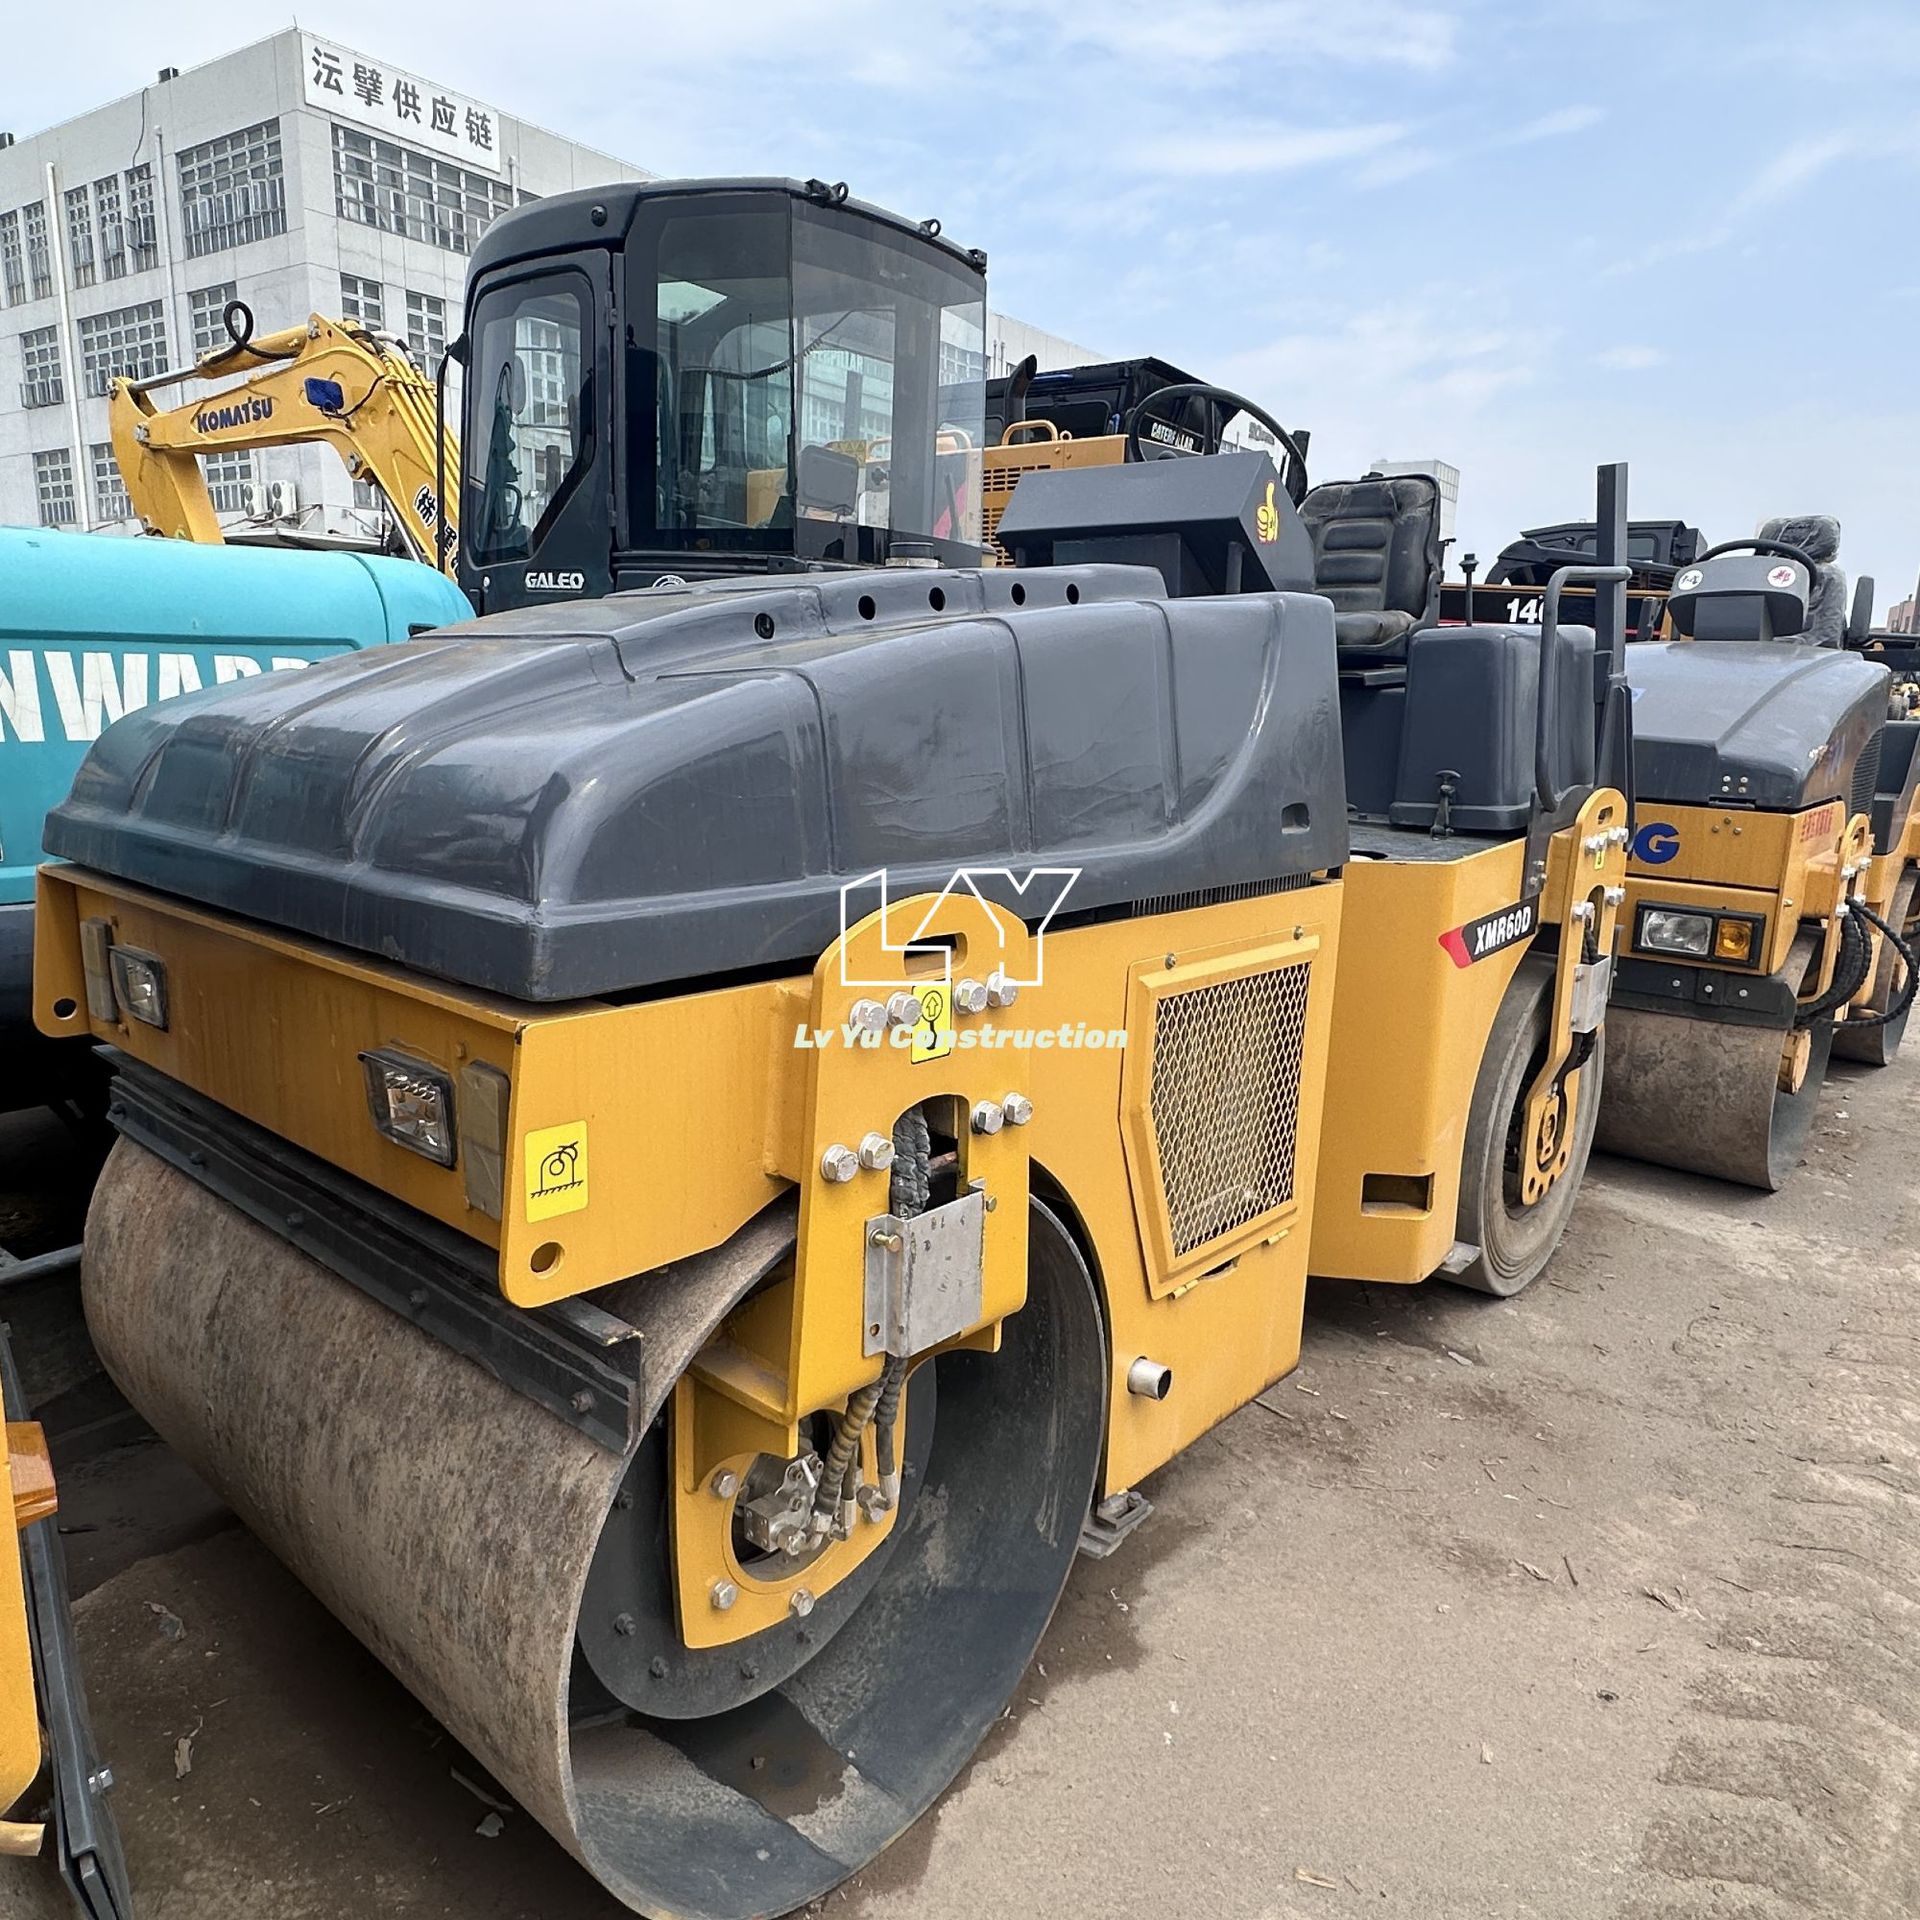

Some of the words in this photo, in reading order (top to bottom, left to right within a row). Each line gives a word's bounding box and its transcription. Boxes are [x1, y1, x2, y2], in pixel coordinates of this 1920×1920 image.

[197, 397, 273, 434] KOMATSU
[525, 572, 585, 589] GALEO
[1474, 905, 1532, 956] XMR60D
